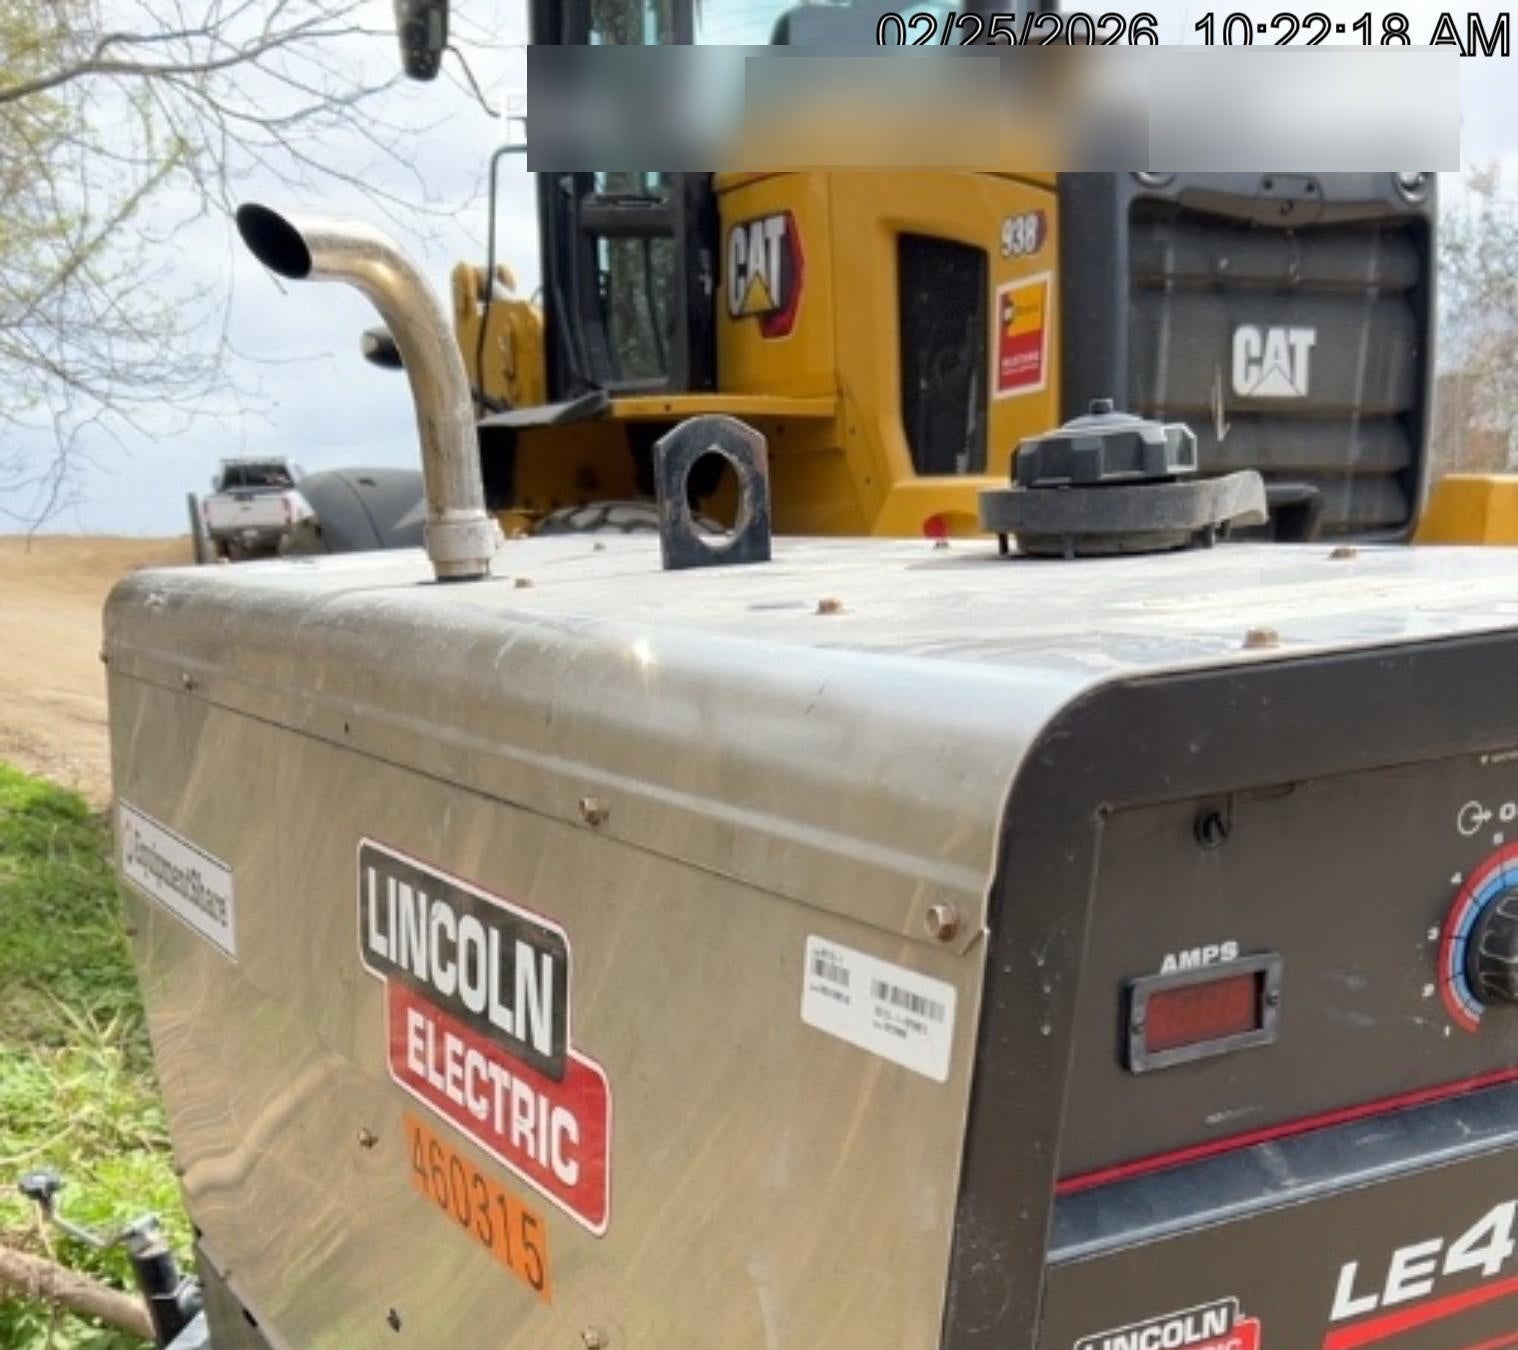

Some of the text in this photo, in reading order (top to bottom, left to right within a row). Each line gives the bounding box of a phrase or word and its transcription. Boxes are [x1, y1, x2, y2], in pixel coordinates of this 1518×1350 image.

[728, 214, 786, 317] CAT
[1232, 324, 1317, 397] CAT
[366, 866, 555, 1057] LINCOLN
[1160, 940, 1239, 976] AMPS
[405, 1006, 580, 1187] ELECTRIC
[411, 1126, 545, 1293] 460315
